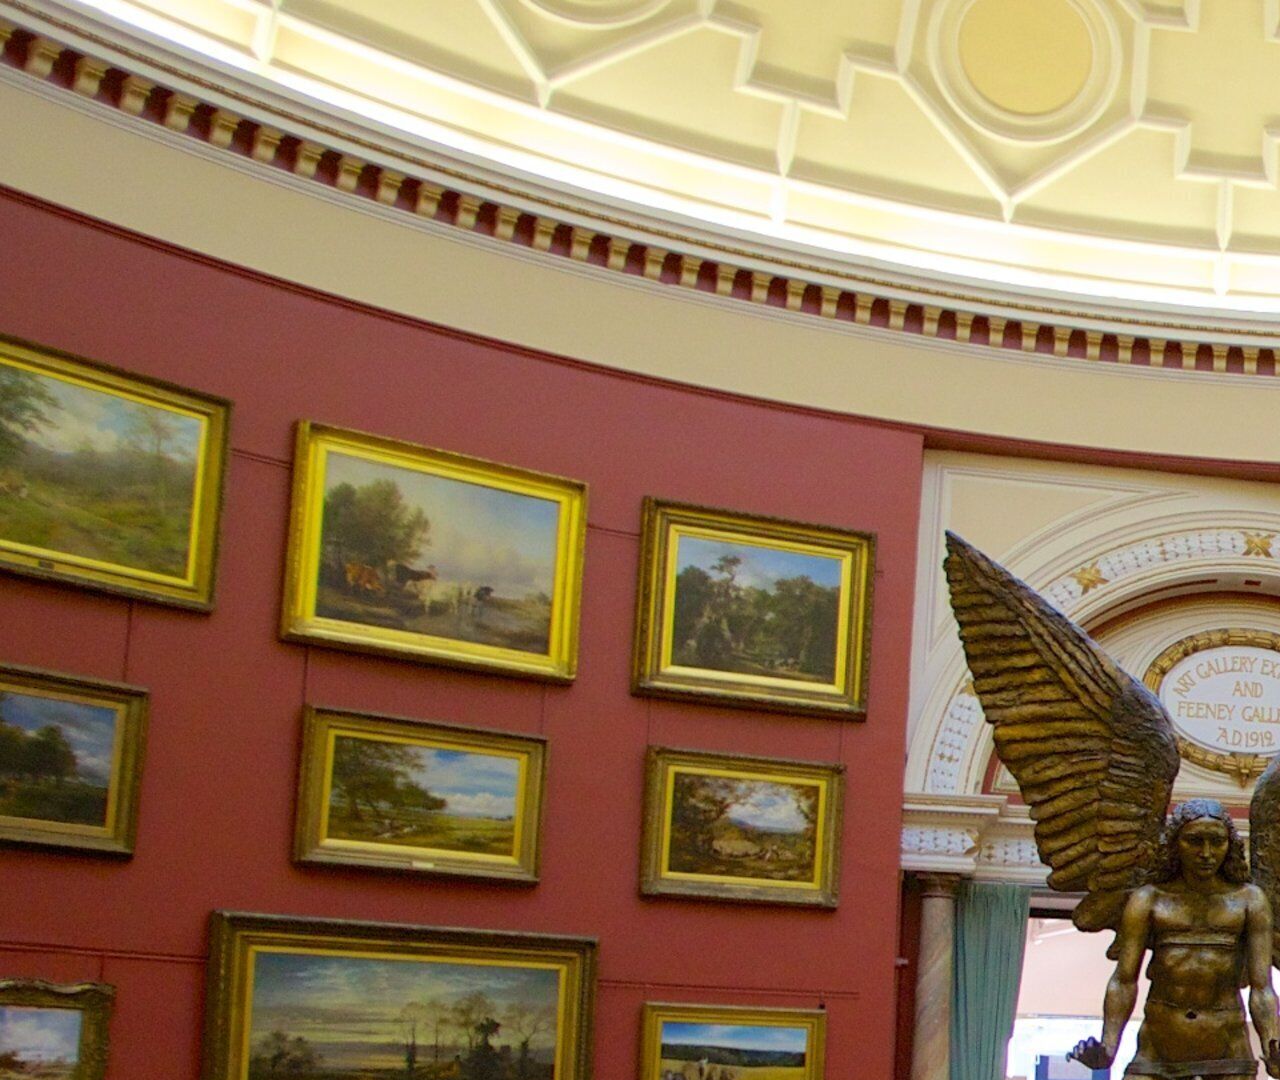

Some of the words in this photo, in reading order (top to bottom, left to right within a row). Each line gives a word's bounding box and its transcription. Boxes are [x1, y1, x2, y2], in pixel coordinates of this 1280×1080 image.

[1173, 670, 1196, 698] ART
[1196, 656, 1258, 679] GALLERY
[1232, 681, 1263, 698] AND
[1177, 702, 1236, 721] FEENEY
[1245, 731, 1276, 748] 1912
